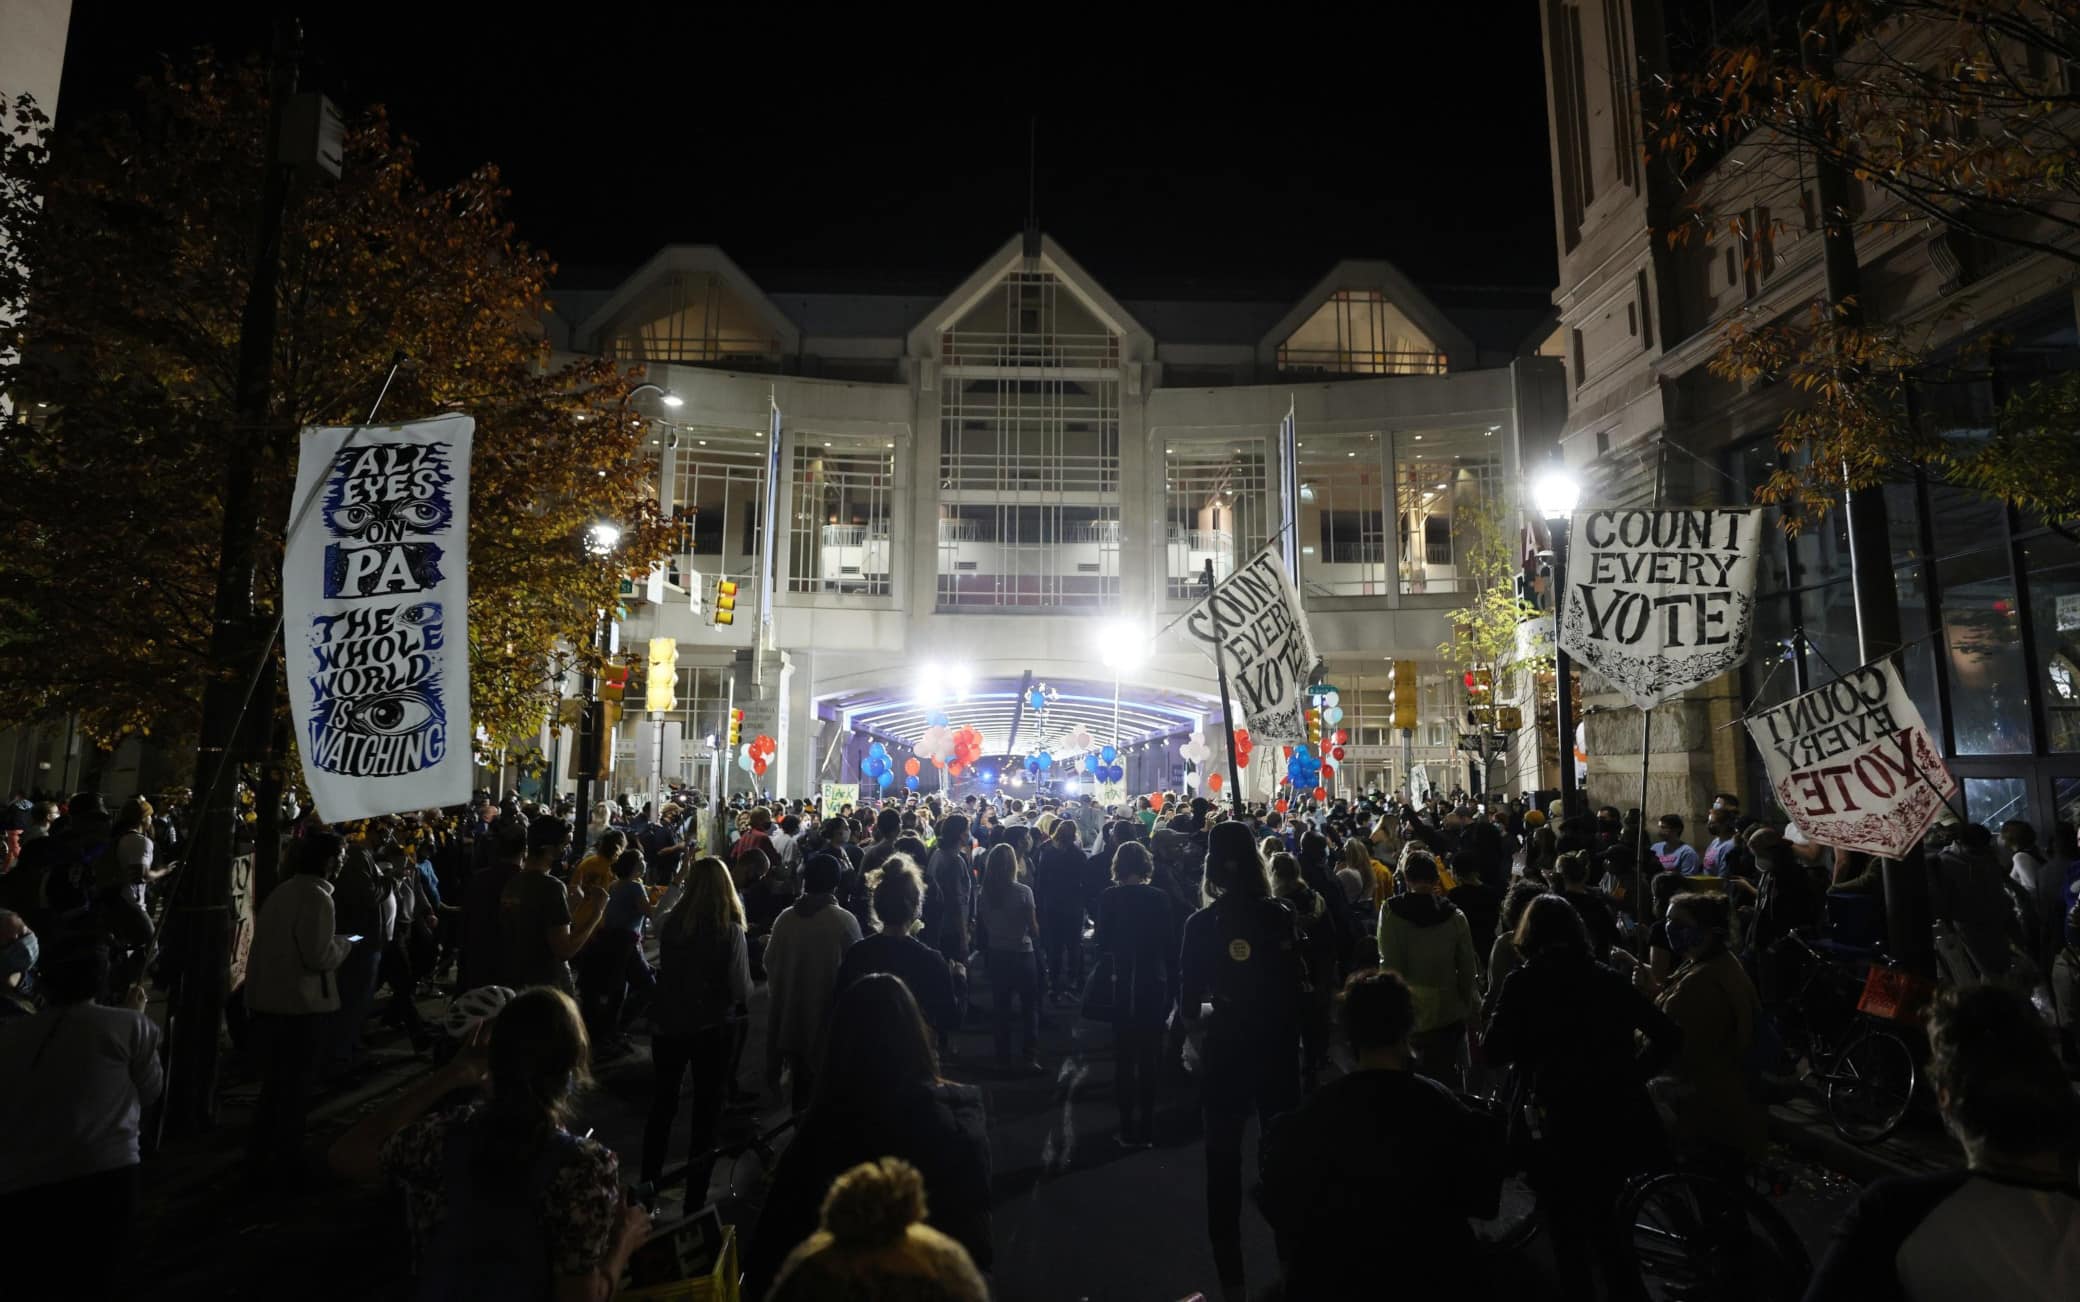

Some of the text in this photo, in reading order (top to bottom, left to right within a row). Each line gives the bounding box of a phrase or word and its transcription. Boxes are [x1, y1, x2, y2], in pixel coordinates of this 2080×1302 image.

[342, 467, 440, 505] EYES
[351, 446, 439, 477] ALL
[365, 519, 407, 544] ON
[1585, 509, 1751, 551] COUNT
[340, 545, 422, 594] PA
[1588, 552, 1742, 588] EVERY
[1187, 552, 1284, 643] COUNT
[1576, 583, 1732, 649] VOTE
[312, 605, 395, 645] THE
[315, 623, 444, 672] WHOLE
[1224, 590, 1294, 673] EVERY
[310, 653, 431, 702] WORLD
[1236, 621, 1303, 715] VOTE
[328, 699, 353, 728] IS
[309, 721, 446, 776] WATCHING
